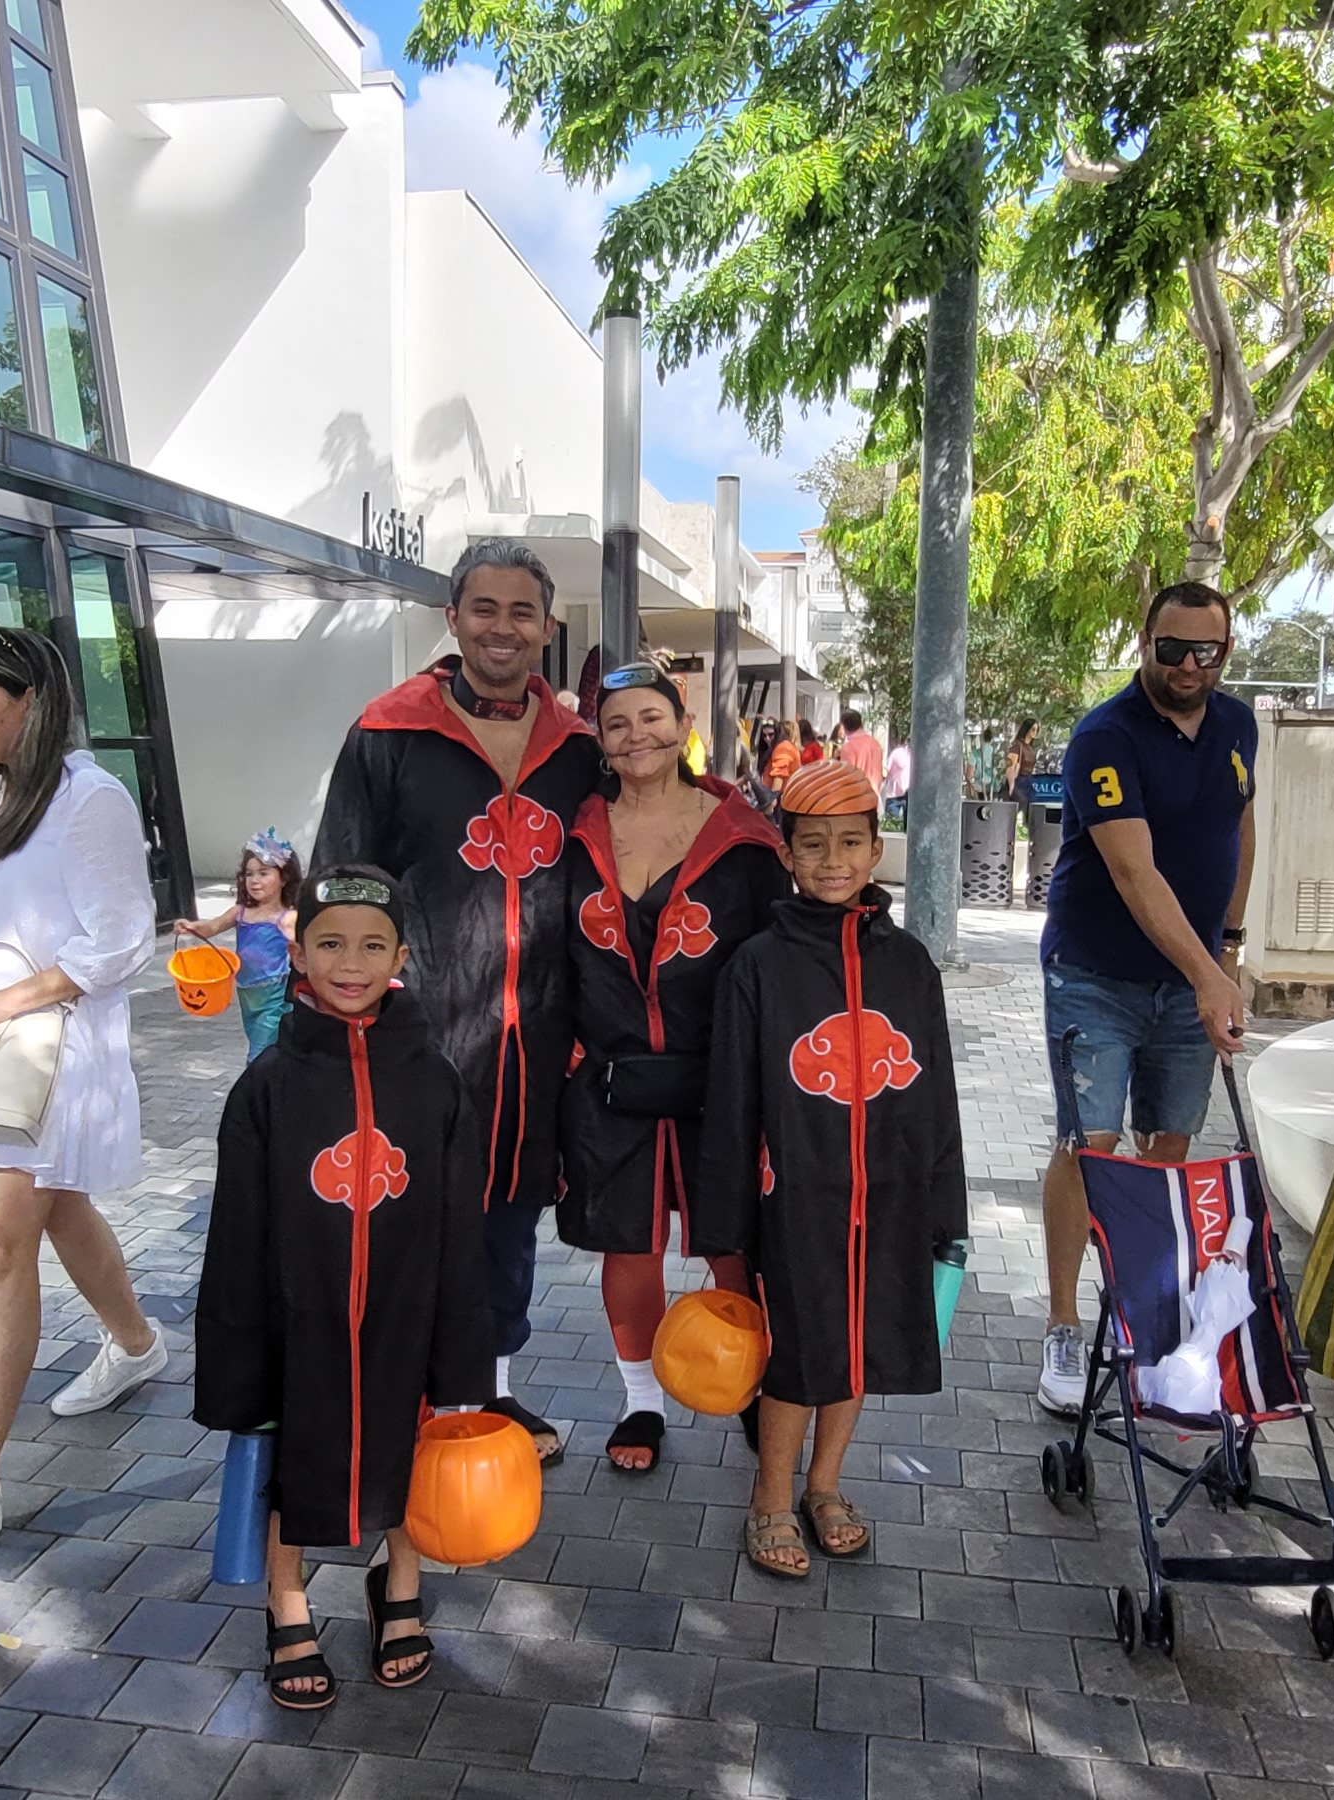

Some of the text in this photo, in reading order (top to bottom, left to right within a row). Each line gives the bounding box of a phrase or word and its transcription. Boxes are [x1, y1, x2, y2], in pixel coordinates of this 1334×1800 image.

[362, 491, 424, 566] kettal
[1090, 765, 1124, 808] 3
[1193, 1178, 1224, 1258] NAU
